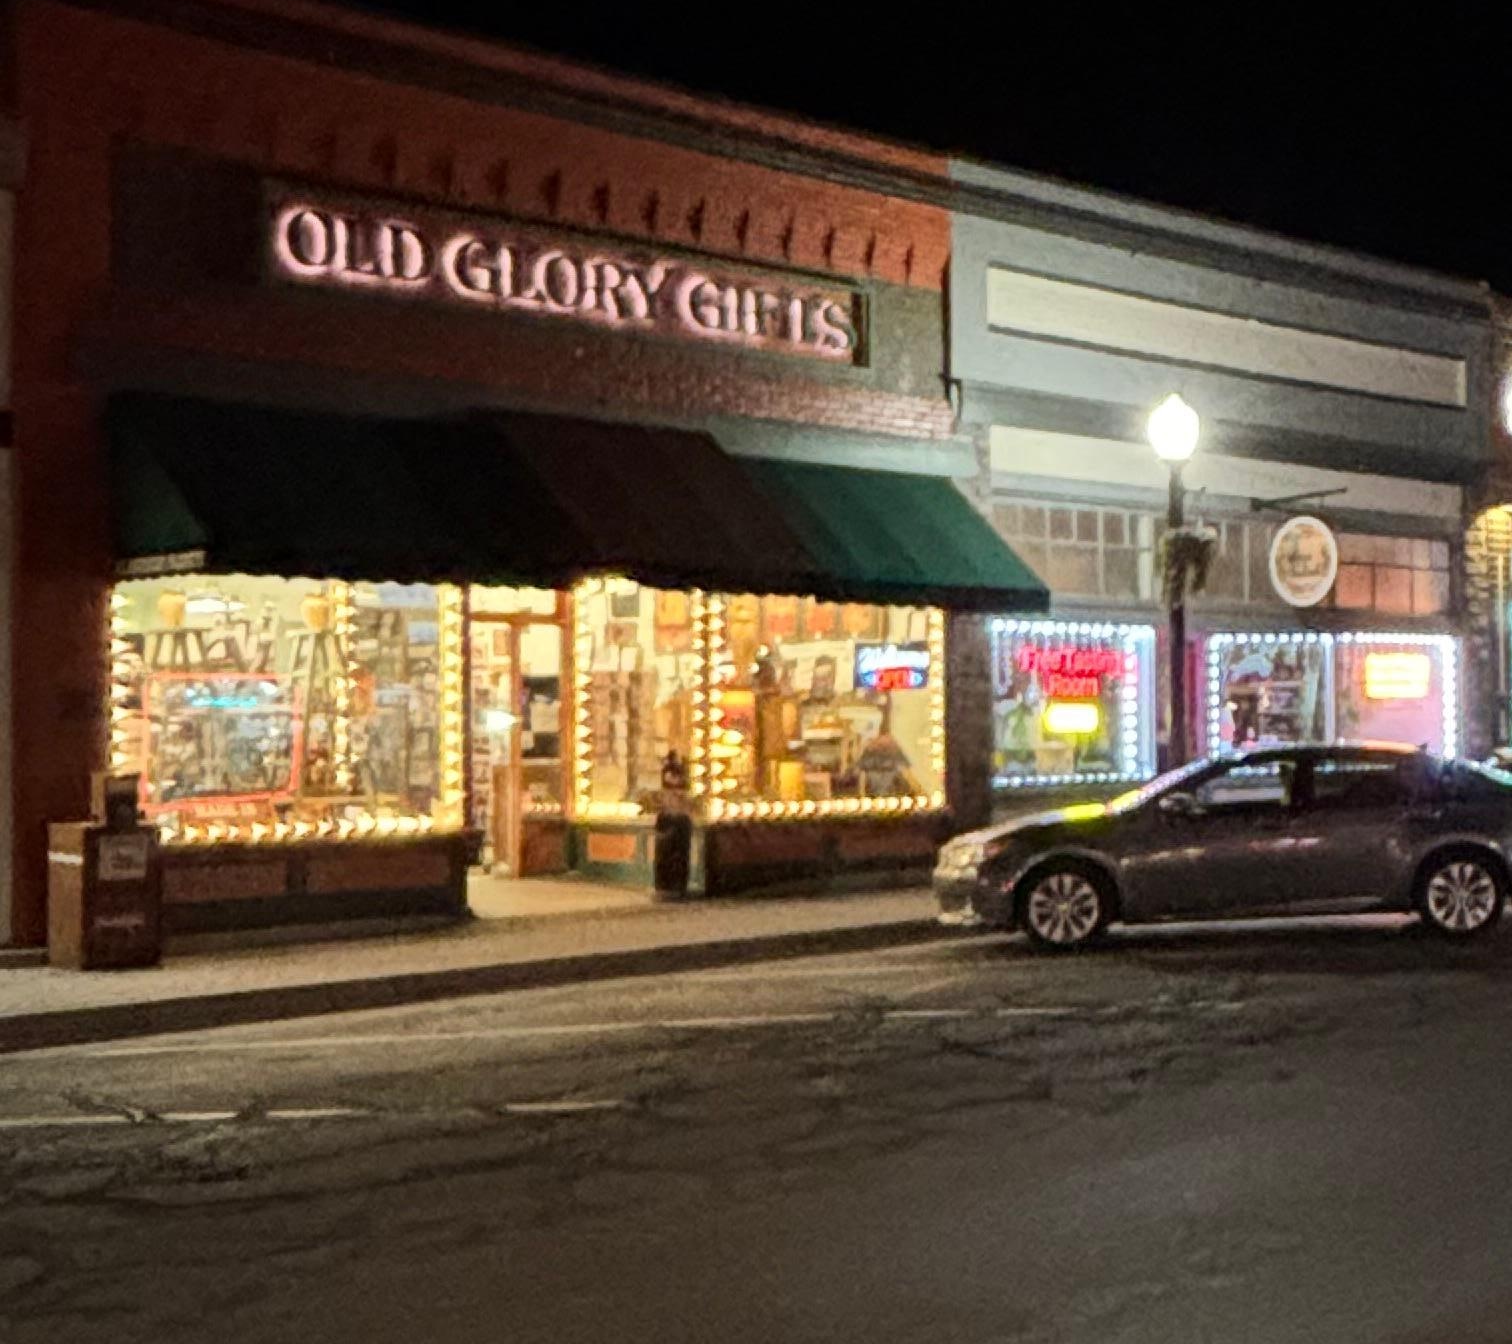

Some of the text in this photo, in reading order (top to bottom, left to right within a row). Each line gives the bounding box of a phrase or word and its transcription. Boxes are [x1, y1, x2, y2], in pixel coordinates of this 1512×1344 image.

[277, 204, 852, 356] OLD GLORY GIFTS
